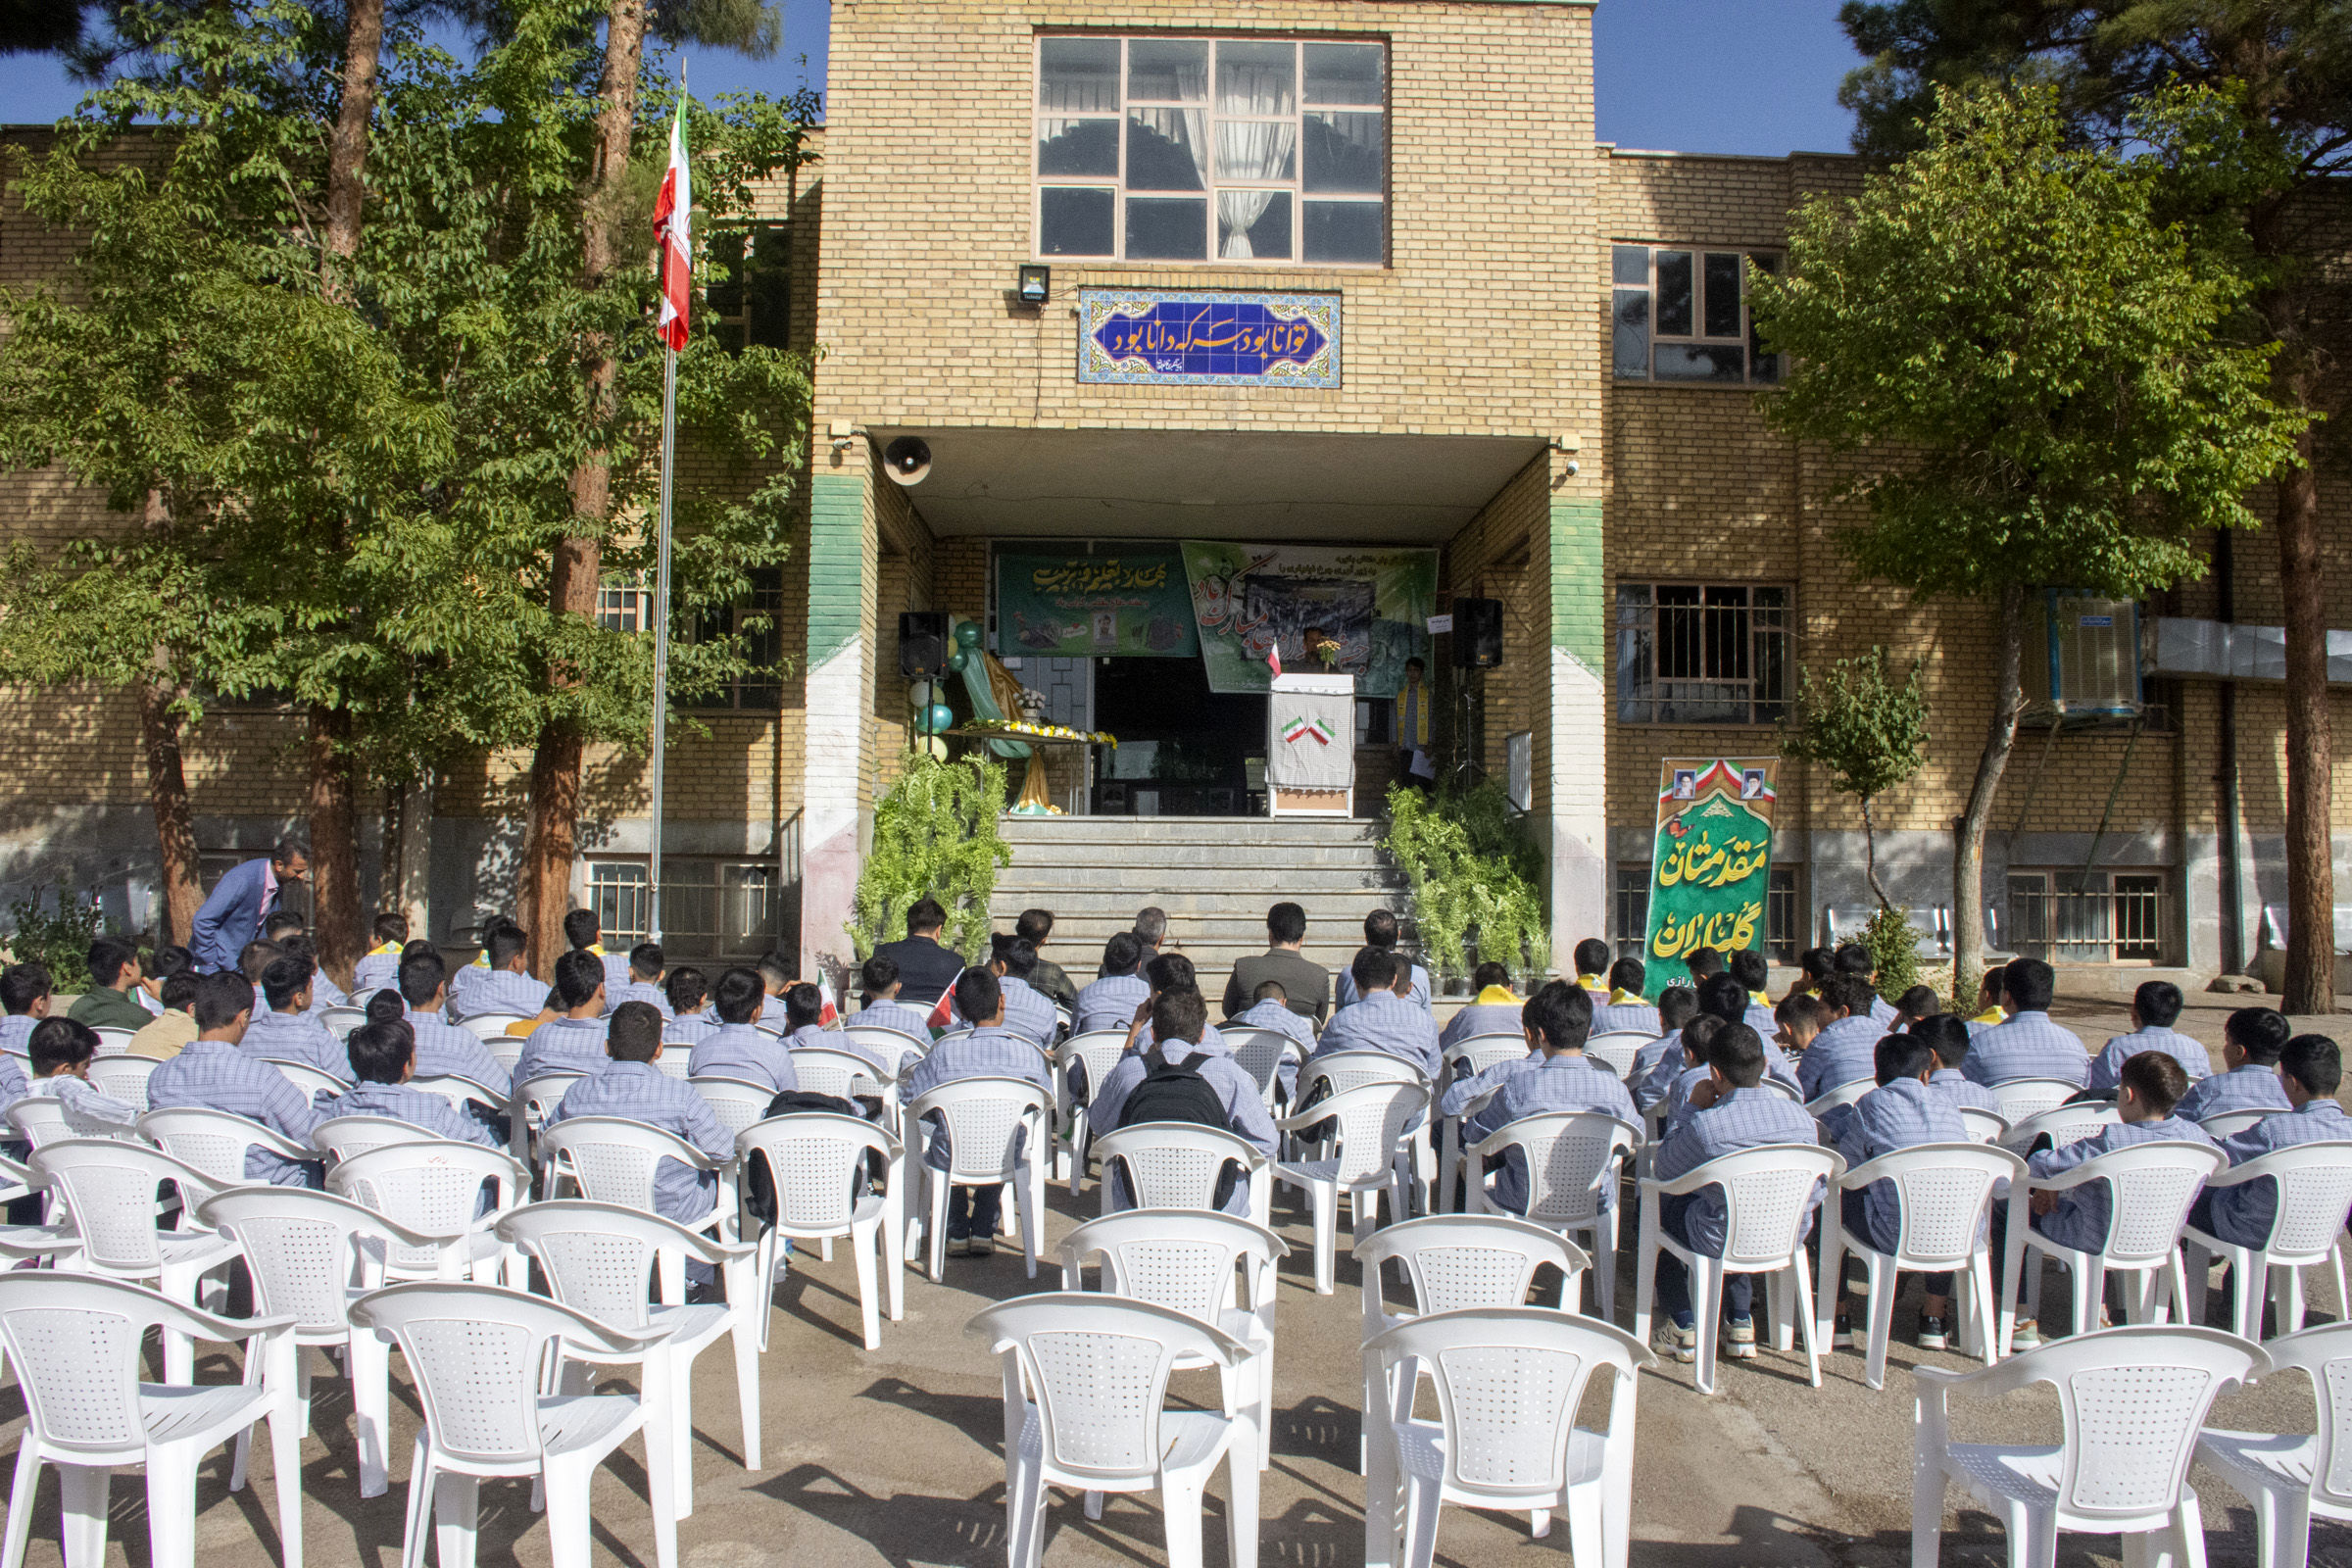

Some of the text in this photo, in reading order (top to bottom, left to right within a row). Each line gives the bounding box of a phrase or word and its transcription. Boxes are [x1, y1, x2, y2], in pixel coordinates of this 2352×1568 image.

[1112, 322, 1143, 353] بود
[1147, 320, 1175, 352] دانا
[1175, 305, 1210, 351] که
[1239, 327, 1271, 360] بود
[1272, 324, 1308, 353] توانا
[1659, 831, 1768, 888] مقدمتان
[1652, 901, 1762, 962] گلباران
[1666, 976, 1690, 988] رازی
